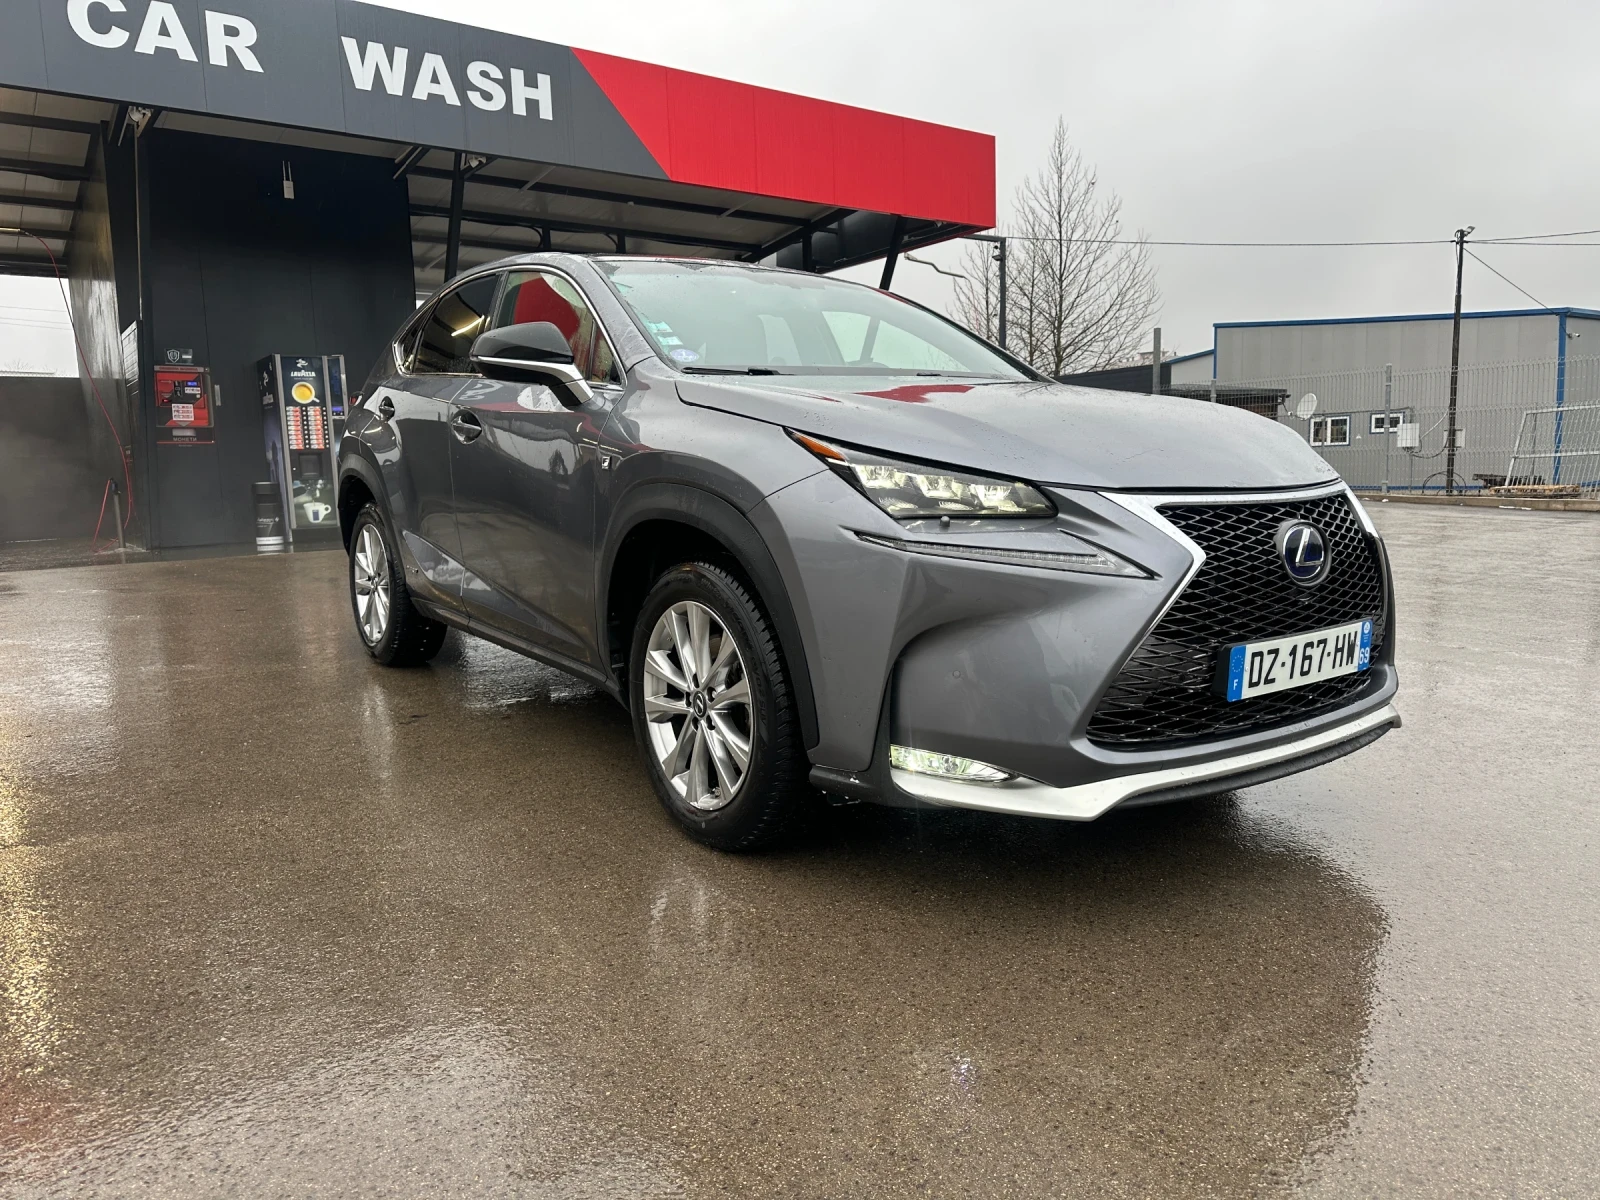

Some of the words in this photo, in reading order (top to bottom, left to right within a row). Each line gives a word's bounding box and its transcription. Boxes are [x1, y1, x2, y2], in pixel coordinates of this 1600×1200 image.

[67, 0, 264, 73] CAR
[341, 36, 553, 121] WASH
[1358, 647, 1370, 665] 69
[1233, 679, 1239, 690] F
